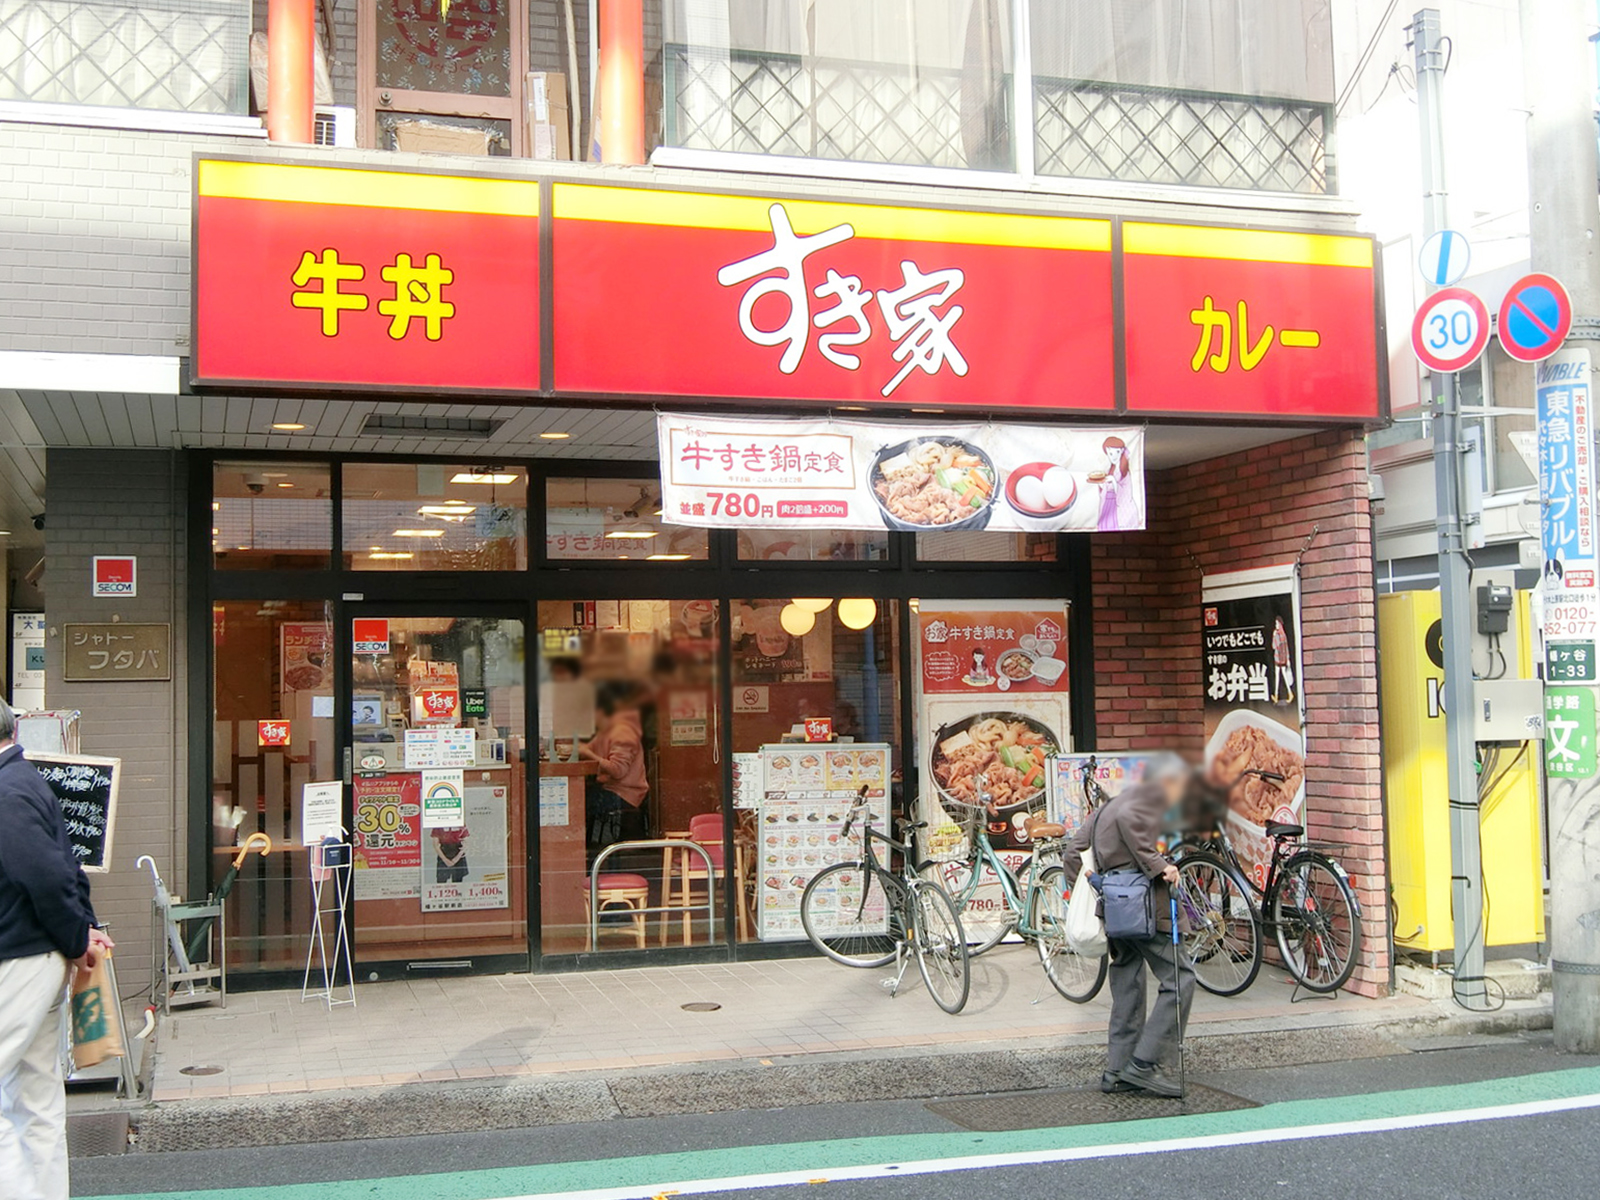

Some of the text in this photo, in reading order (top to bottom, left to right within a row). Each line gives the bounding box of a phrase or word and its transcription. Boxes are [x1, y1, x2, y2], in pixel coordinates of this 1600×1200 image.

[291, 247, 456, 341] 牛丼
[718, 203, 968, 397] すき家
[1190, 295, 1321, 373] カレー
[1429, 310, 1472, 349] 30
[680, 440, 845, 474] 牛すき鍋定食
[1545, 390, 1576, 548] 東急リバブル
[546, 531, 649, 551] すき鍋定食
[98, 583, 132, 592] SECOM
[1554, 606, 1594, 621] 0120-
[74, 633, 134, 646] シャトー
[949, 625, 1016, 641] 牛すき鍋定食
[1206, 630, 1265, 648] いつでもどこでも
[355, 642, 387, 651] SECOM
[87, 649, 161, 671] フタバ
[1550, 664, 1587, 678] 1-33
[1207, 662, 1270, 702] お弁当
[465, 697, 485, 705] Uber
[465, 705, 485, 713] Eats
[1547, 713, 1580, 761] 文
[358, 804, 411, 834] 30%
